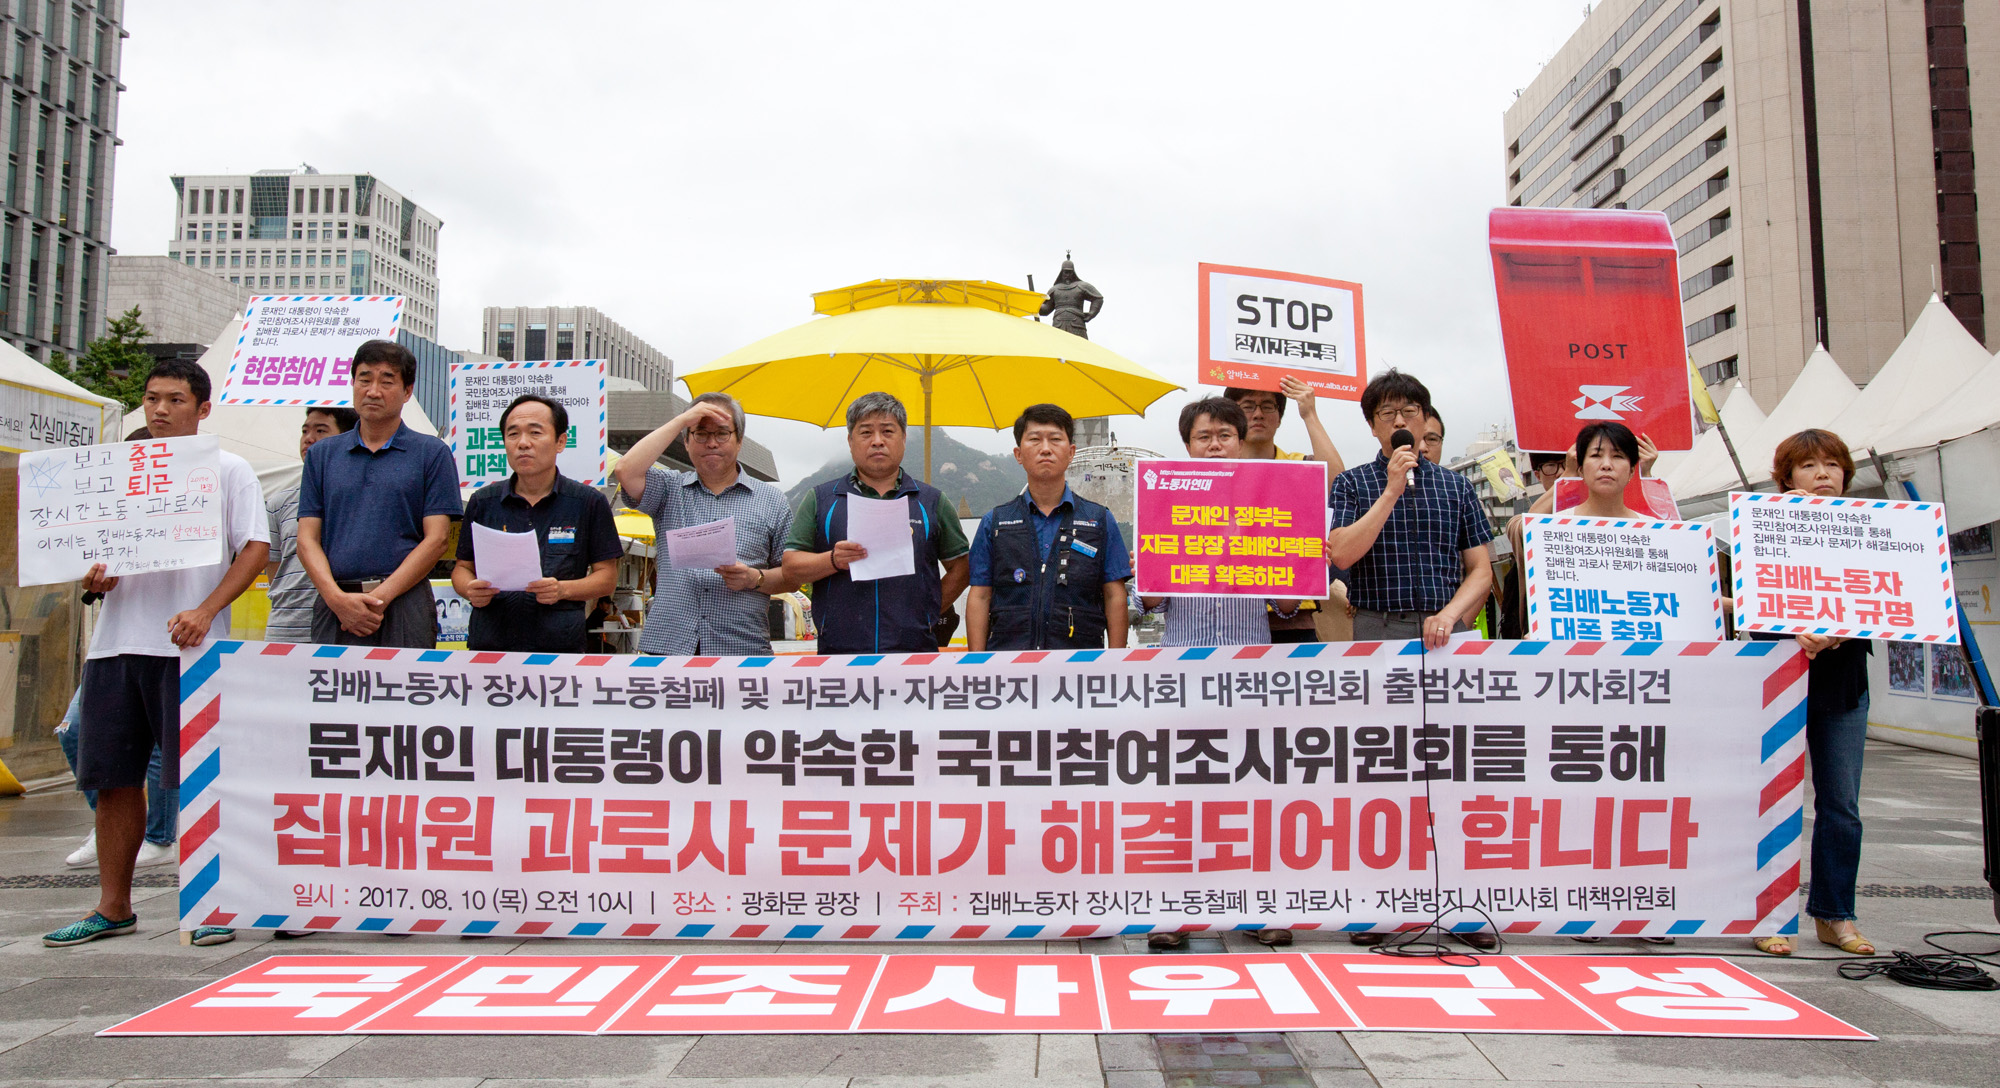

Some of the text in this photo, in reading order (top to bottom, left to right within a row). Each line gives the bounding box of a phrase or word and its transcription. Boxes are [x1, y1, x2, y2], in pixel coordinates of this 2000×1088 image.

[261, 306, 349, 316] 문재인 대통령이 약속한
[1236, 294, 1333, 333] STOP
[258, 317, 360, 326] 국민참여조사위원회를 통해
[255, 327, 380, 337] 집배원 과로사 문제가 해결되어야
[252, 338, 279, 347] 합니다.
[1236, 334, 1336, 362] 장시간중노동
[1568, 343, 1628, 360] POST
[241, 355, 354, 387] 현장참여 보
[465, 374, 553, 387] 문재인 대통령이 약속한
[1226, 369, 1260, 381] 알바노조
[549, 385, 567, 396] 통해
[1306, 379, 1358, 393] www.alba.or.kr
[465, 400, 490, 411] 집배원
[465, 411, 493, 422] 합니다.
[29, 413, 94, 448] 진실마중대
[73, 443, 173, 472] 보고 출근
[466, 454, 507, 477] 대책
[73, 474, 173, 497] 보고 퇴근
[1158, 478, 1213, 491] 노동자연대
[1171, 505, 1293, 528] 문재인 정부는
[1751, 507, 1872, 525] 문재인 대통령이 약속한
[38, 534, 87, 550] 이제는
[97, 528, 167, 545] 집배노동자의
[1542, 531, 1651, 546] 문재인 대통령이 약속한
[1752, 520, 1891, 539] 국민참여조사위원회를 통해
[1140, 534, 1323, 558] 지금 당장 집배인력을
[1544, 543, 1669, 560] 국민참여조사위원회를 통해
[1753, 533, 1925, 554] 집배원 과로사 문제가 해결되어야
[1754, 546, 1791, 558] 합니다.
[1170, 564, 1295, 587] 대폭 확충하라
[1545, 557, 1698, 574] 집배원 과로사 문제가 해결되어야
[1546, 569, 1579, 582] 합니다.
[1755, 563, 1903, 597] 집배노동자
[1548, 587, 1680, 618] 집배노동자
[1757, 592, 1915, 628] 과로사 규명
[307, 667, 472, 707] 집배노동자
[482, 672, 582, 708] 장시간
[592, 674, 725, 710] 노동철폐
[739, 676, 769, 709] 및
[1052, 672, 1187, 709] 시민사회
[1201, 669, 1369, 708] 대책위원회
[1383, 667, 1521, 705] 출범선포
[1534, 667, 1671, 705] 기자회견
[308, 722, 1666, 787] 문재인 대통령이 약속한 국민참여조사위원회를 통해
[273, 792, 1699, 876] 집배원 과로사 문제가 해결되어야 합니다
[292, 883, 335, 909] 일시
[359, 886, 415, 912] 2017.
[421, 888, 453, 912] 08.
[534, 889, 580, 914] 오전
[588, 889, 634, 915] 10시
[672, 891, 716, 917] 장소
[741, 891, 806, 917] 광화문
[814, 891, 860, 917] 광장
[898, 890, 943, 917] 주최
[968, 890, 1079, 917] 집배노동자
[1086, 889, 1152, 917] 장시간
[1159, 888, 1248, 916] 노동철폐
[1256, 888, 1277, 914] 및
[1472, 886, 1559, 912] 시민사회
[1568, 885, 1676, 912] 대책위원회
